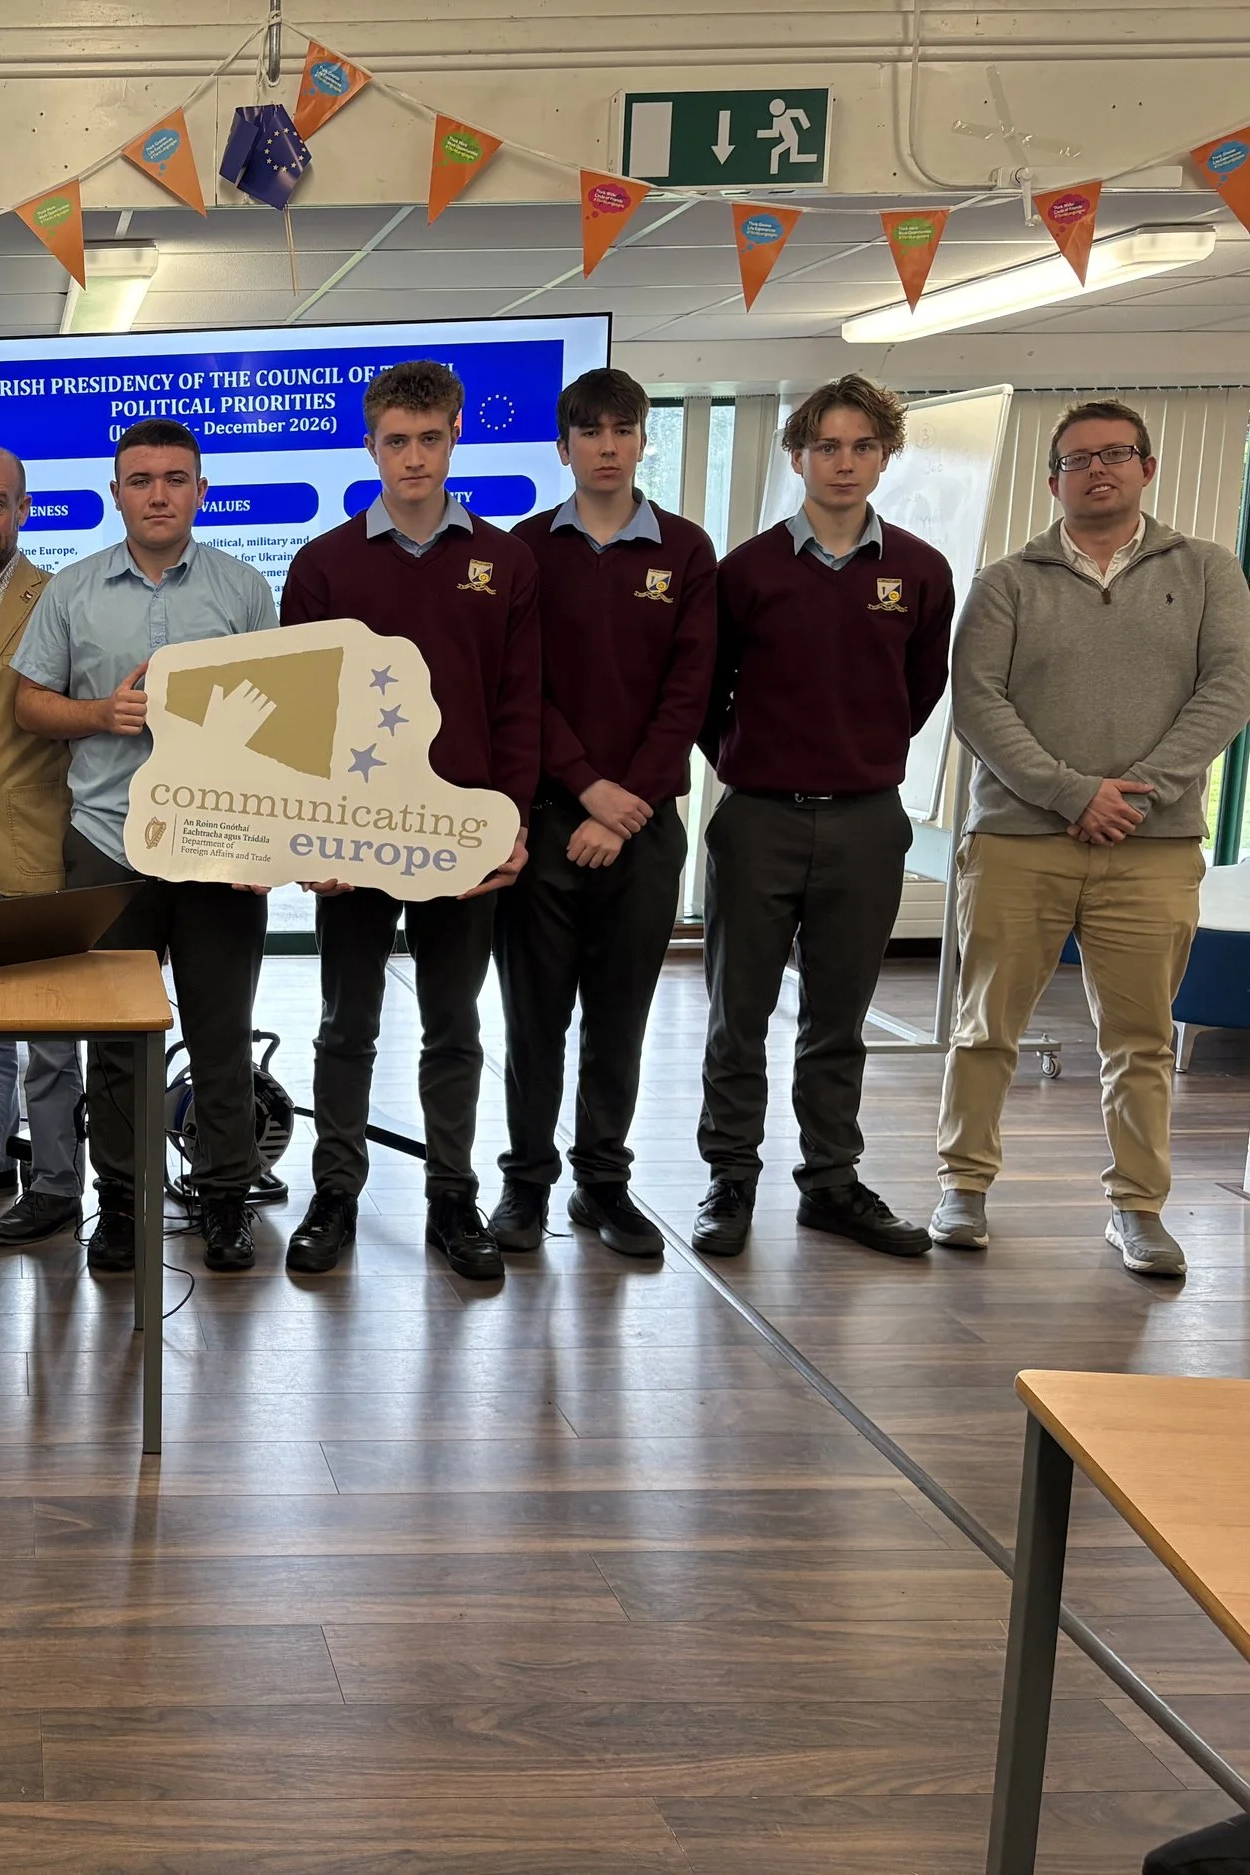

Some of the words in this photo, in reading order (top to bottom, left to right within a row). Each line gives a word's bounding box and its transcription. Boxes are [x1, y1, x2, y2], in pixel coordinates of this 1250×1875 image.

[50, 374, 174, 394] PRESIDENCY
[178, 372, 204, 390] OF
[209, 371, 250, 388] THE
[256, 367, 343, 387] COUNCIL
[348, 366, 375, 383] OF
[110, 397, 216, 418] POLITICAL
[220, 392, 336, 412] PRIORITIES
[204, 418, 285, 434] December
[290, 416, 337, 434] 2026)
[202, 500, 250, 512] VALUES
[247, 536, 288, 547] military
[290, 536, 310, 545] and
[39, 546, 78, 556] Europe,
[242, 553, 256, 562] for
[259, 552, 294, 562] Ukrain
[150, 782, 488, 848] communicating
[196, 820, 218, 828] Roinn
[183, 828, 222, 838] Eachtracha
[182, 837, 224, 848] Department
[181, 846, 208, 856] Foreign
[210, 850, 234, 858] Affairs
[251, 853, 271, 862] Trade
[290, 833, 458, 877] europe
